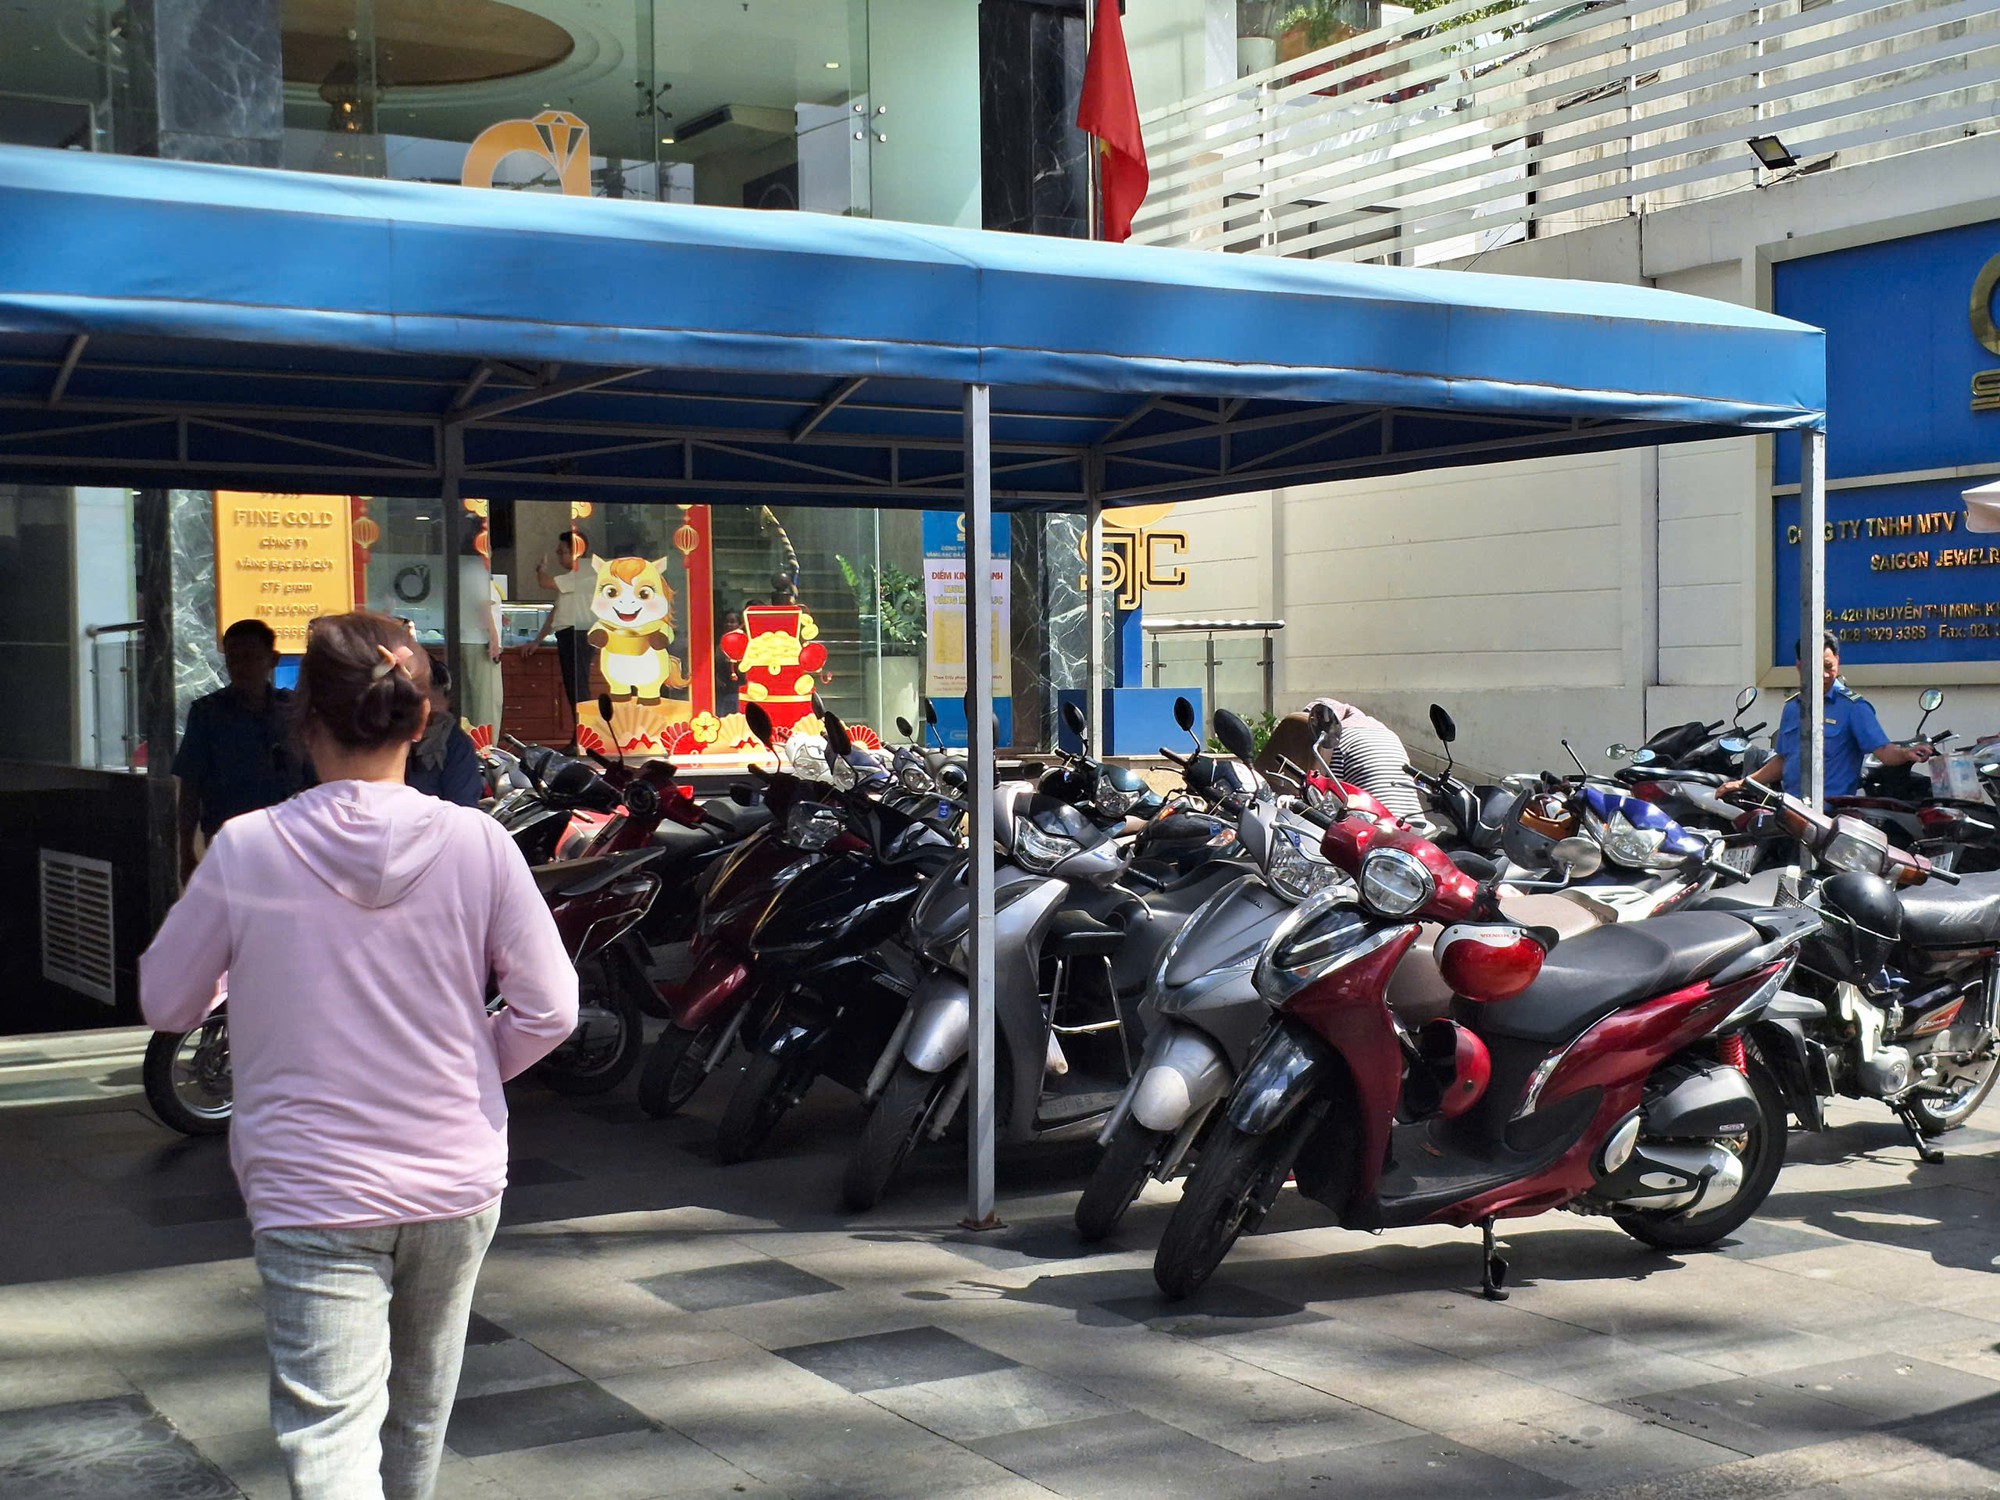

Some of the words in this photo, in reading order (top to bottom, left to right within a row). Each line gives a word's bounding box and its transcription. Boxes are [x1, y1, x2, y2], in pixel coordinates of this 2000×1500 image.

[233, 508, 281, 528] FINE
[283, 510, 334, 529] GOLD
[1838, 519, 1861, 540] TY
[1865, 514, 1914, 538] TNHH
[1917, 511, 1957, 534] MTV
[1079, 527, 1189, 611] SJC
[1869, 551, 1929, 571] SAIGON
